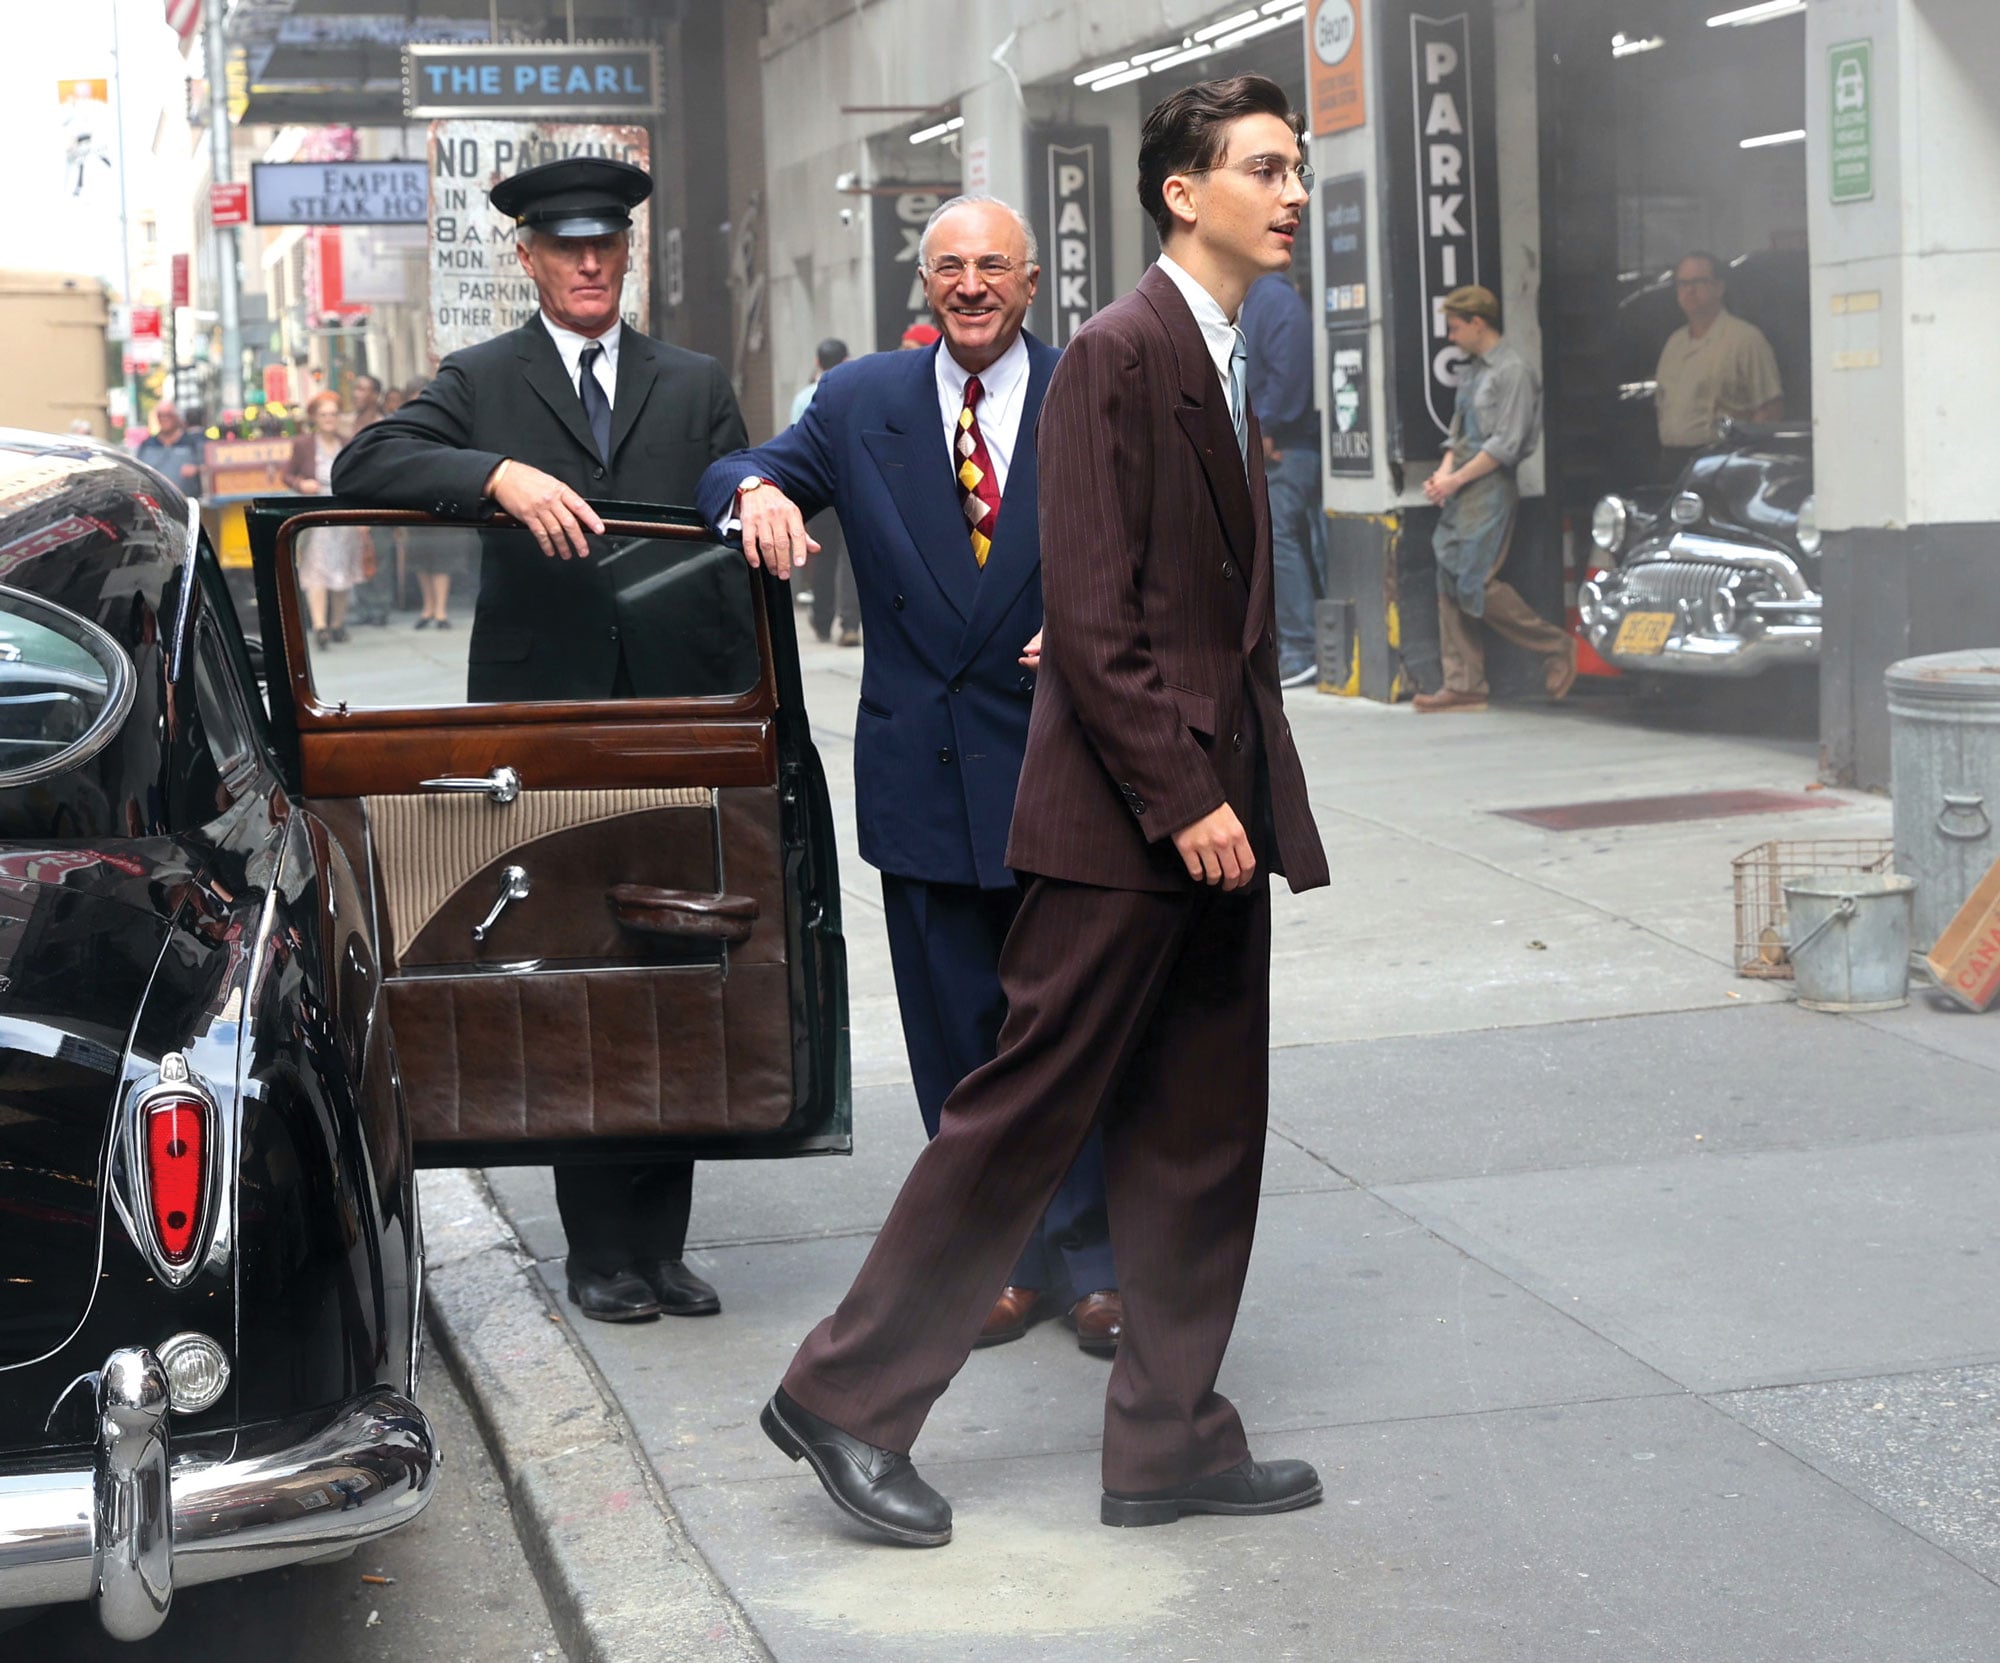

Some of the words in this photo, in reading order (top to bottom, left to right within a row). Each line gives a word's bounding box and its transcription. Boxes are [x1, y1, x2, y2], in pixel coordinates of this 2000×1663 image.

[1319, 14, 1349, 47] Beam
[424, 65, 502, 95] THE
[514, 65, 644, 95] PEARL
[436, 138, 478, 178] NO
[289, 196, 370, 218] STEAK
[444, 188, 467, 210] IN
[1424, 41, 1468, 388] PARKIG
[438, 250, 489, 269] MON.
[439, 307, 491, 326] OTHER
[1332, 431, 1369, 458] HOURS
